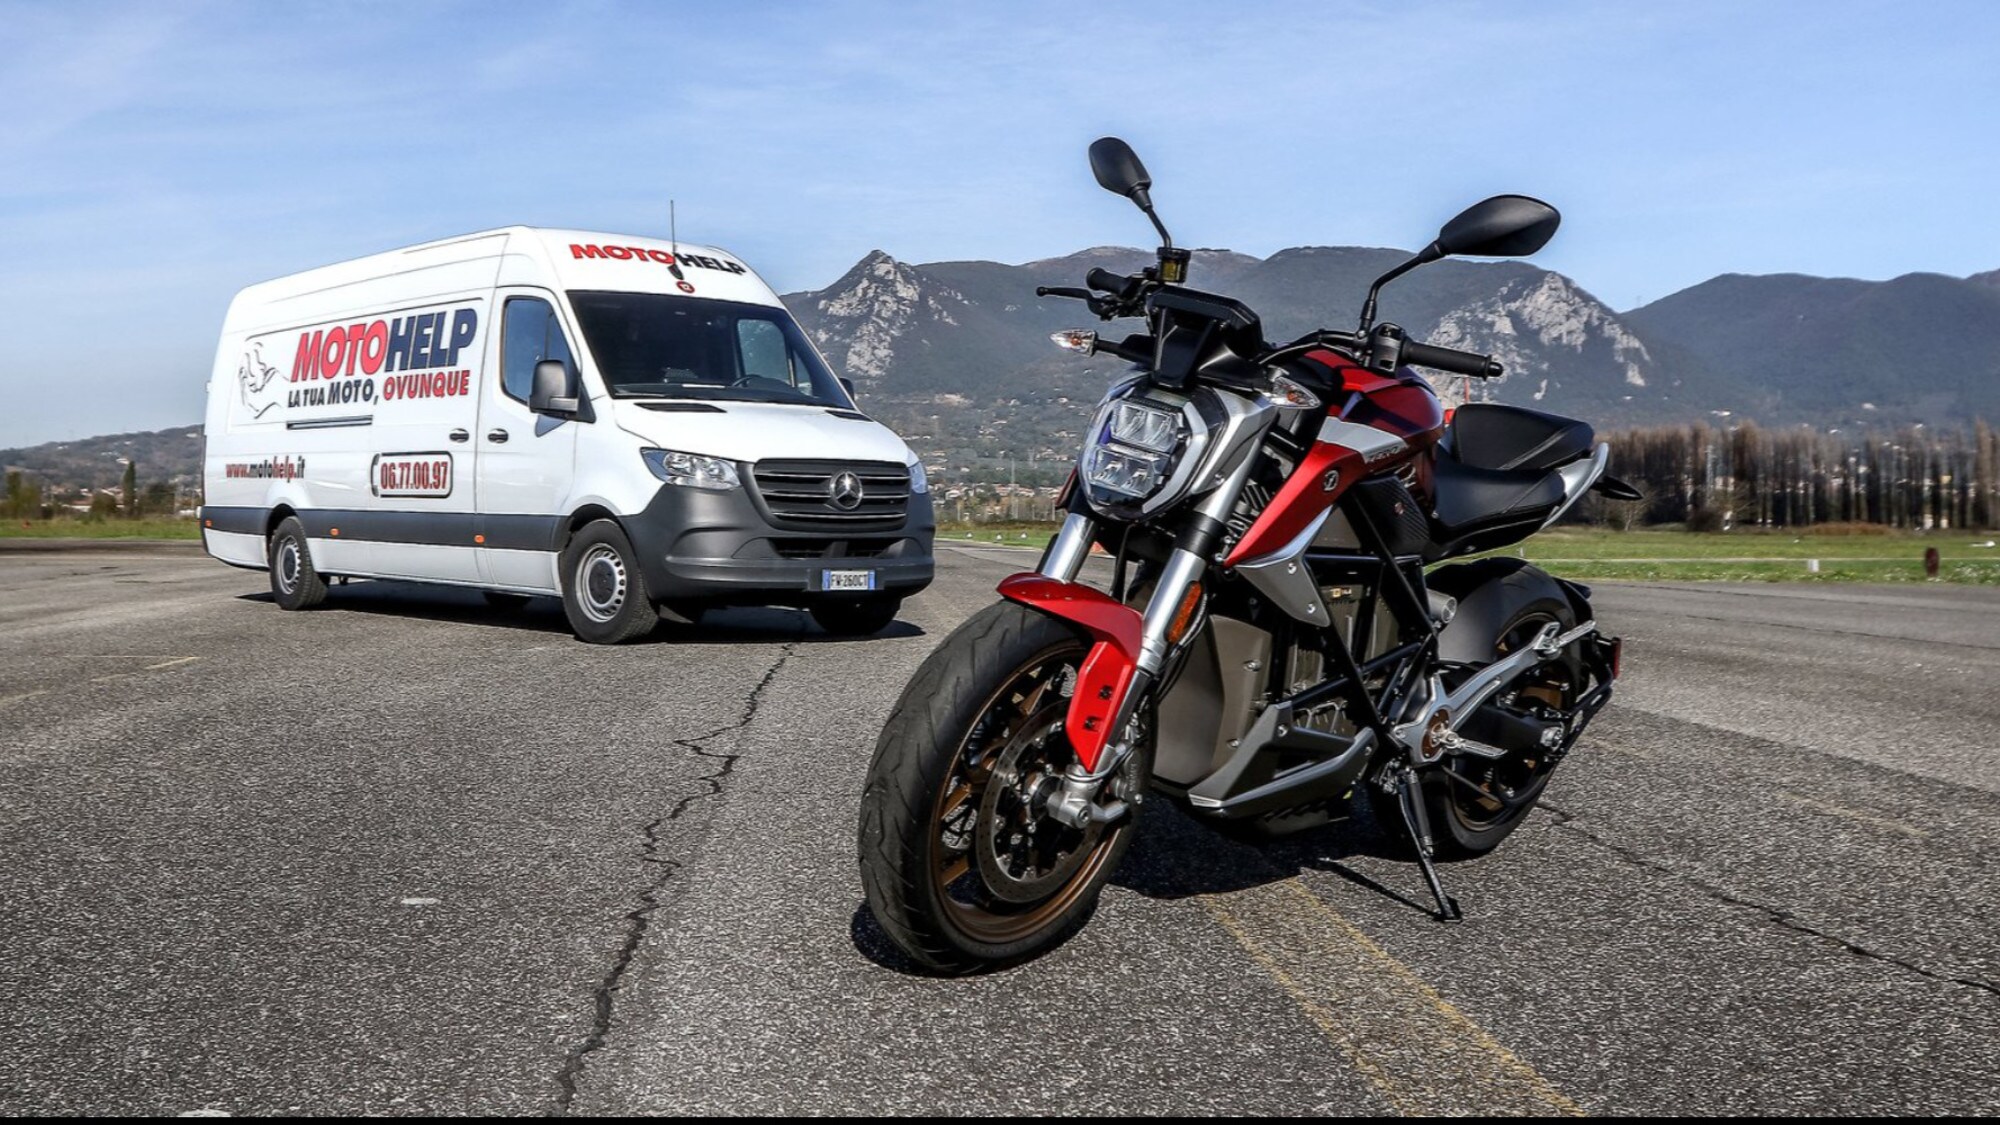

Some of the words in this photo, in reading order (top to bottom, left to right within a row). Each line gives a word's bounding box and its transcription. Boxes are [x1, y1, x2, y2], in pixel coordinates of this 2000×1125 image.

[568, 243, 746, 276] MOTOHELP
[290, 308, 478, 382] MOTOHELP
[288, 390, 301, 408] LA
[303, 387, 325, 406] TUA
[327, 378, 379, 405] MOTO,
[383, 370, 471, 401] OVUNQUE
[226, 455, 305, 483] www.motohelp.it
[381, 461, 448, 489] 06.77.00.97
